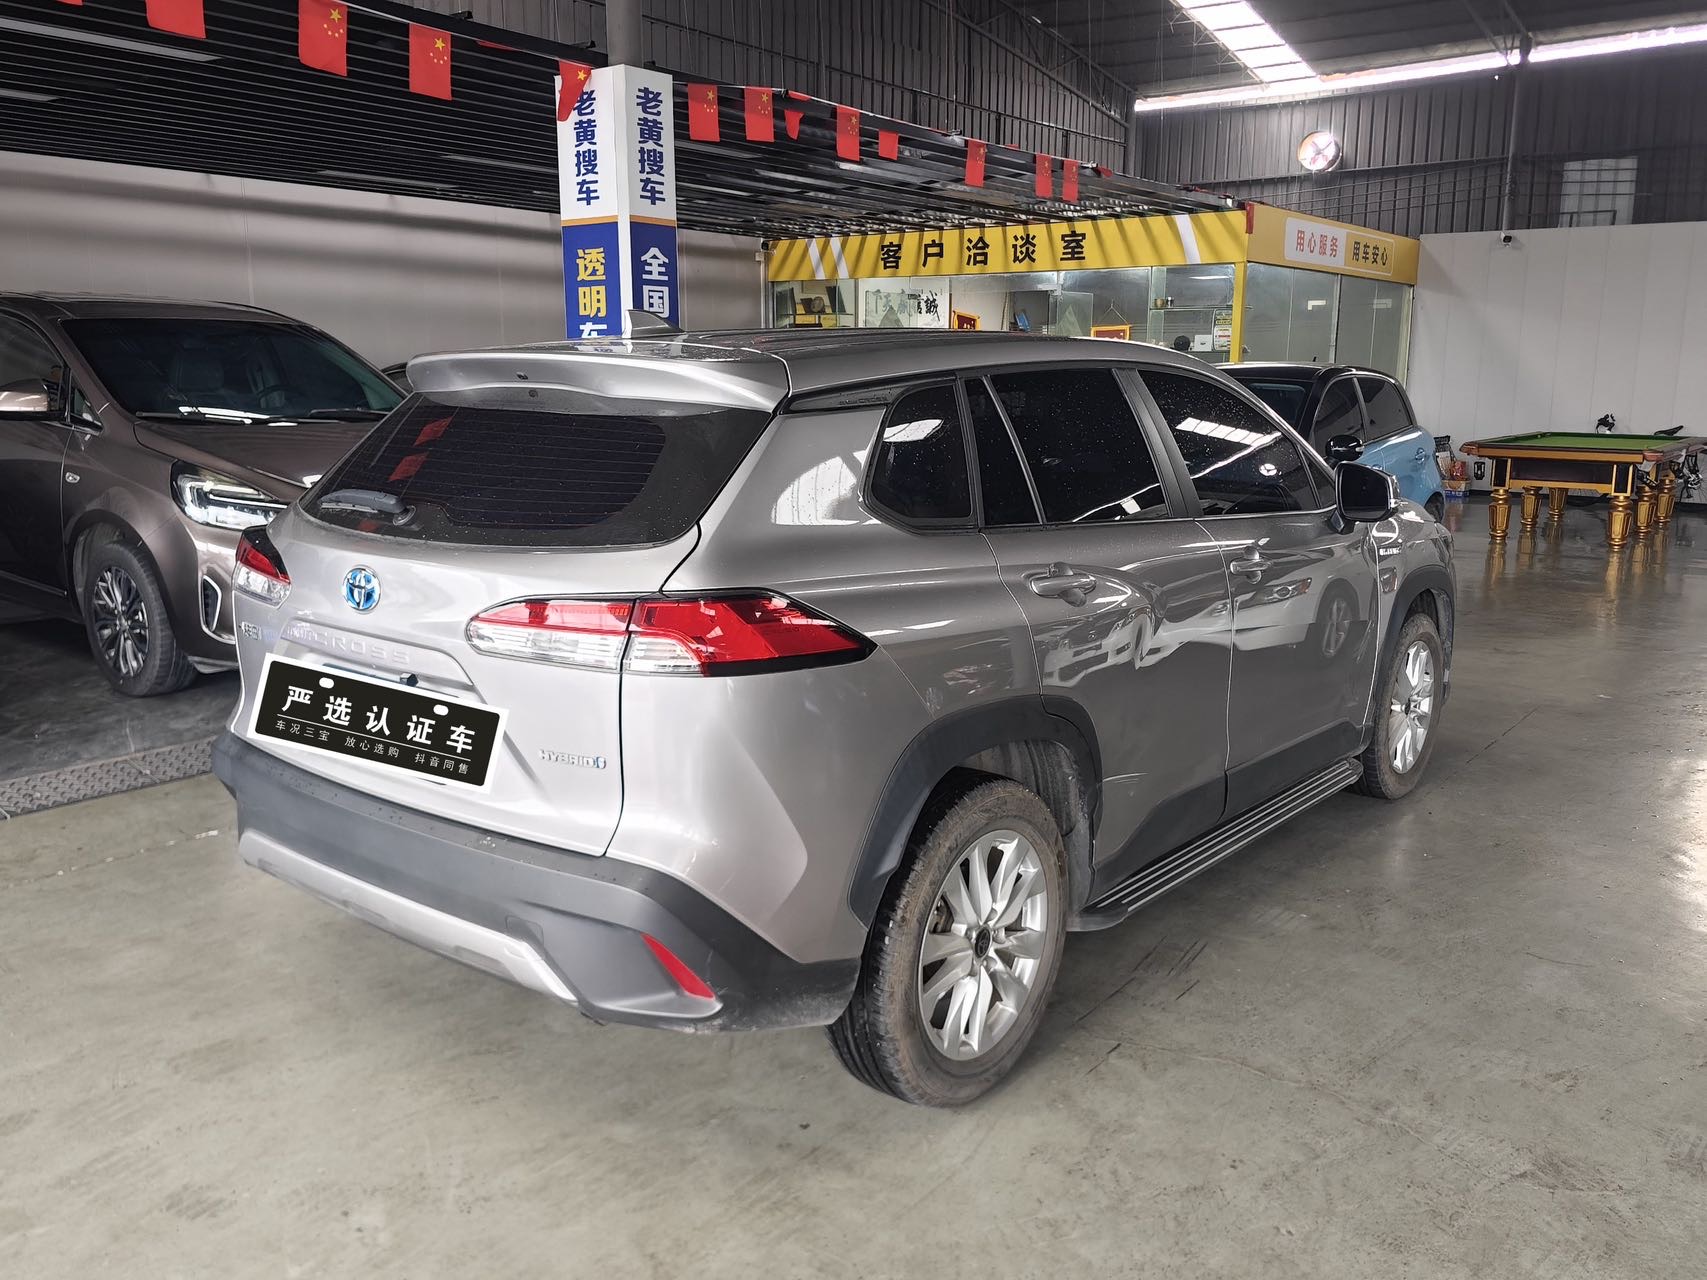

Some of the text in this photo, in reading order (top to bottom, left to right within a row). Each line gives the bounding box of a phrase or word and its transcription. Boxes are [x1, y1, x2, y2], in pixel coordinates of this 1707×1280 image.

[573, 89, 600, 206] 老黄搜车
[636, 86, 666, 206] 老黄搜车
[880, 230, 1087, 270] 客户洽谈室
[1295, 229, 1339, 258] 用心服务
[1352, 240, 1388, 266] 用车安心
[640, 246, 669, 319] 全国
[539, 748, 596, 768] HYBRID
